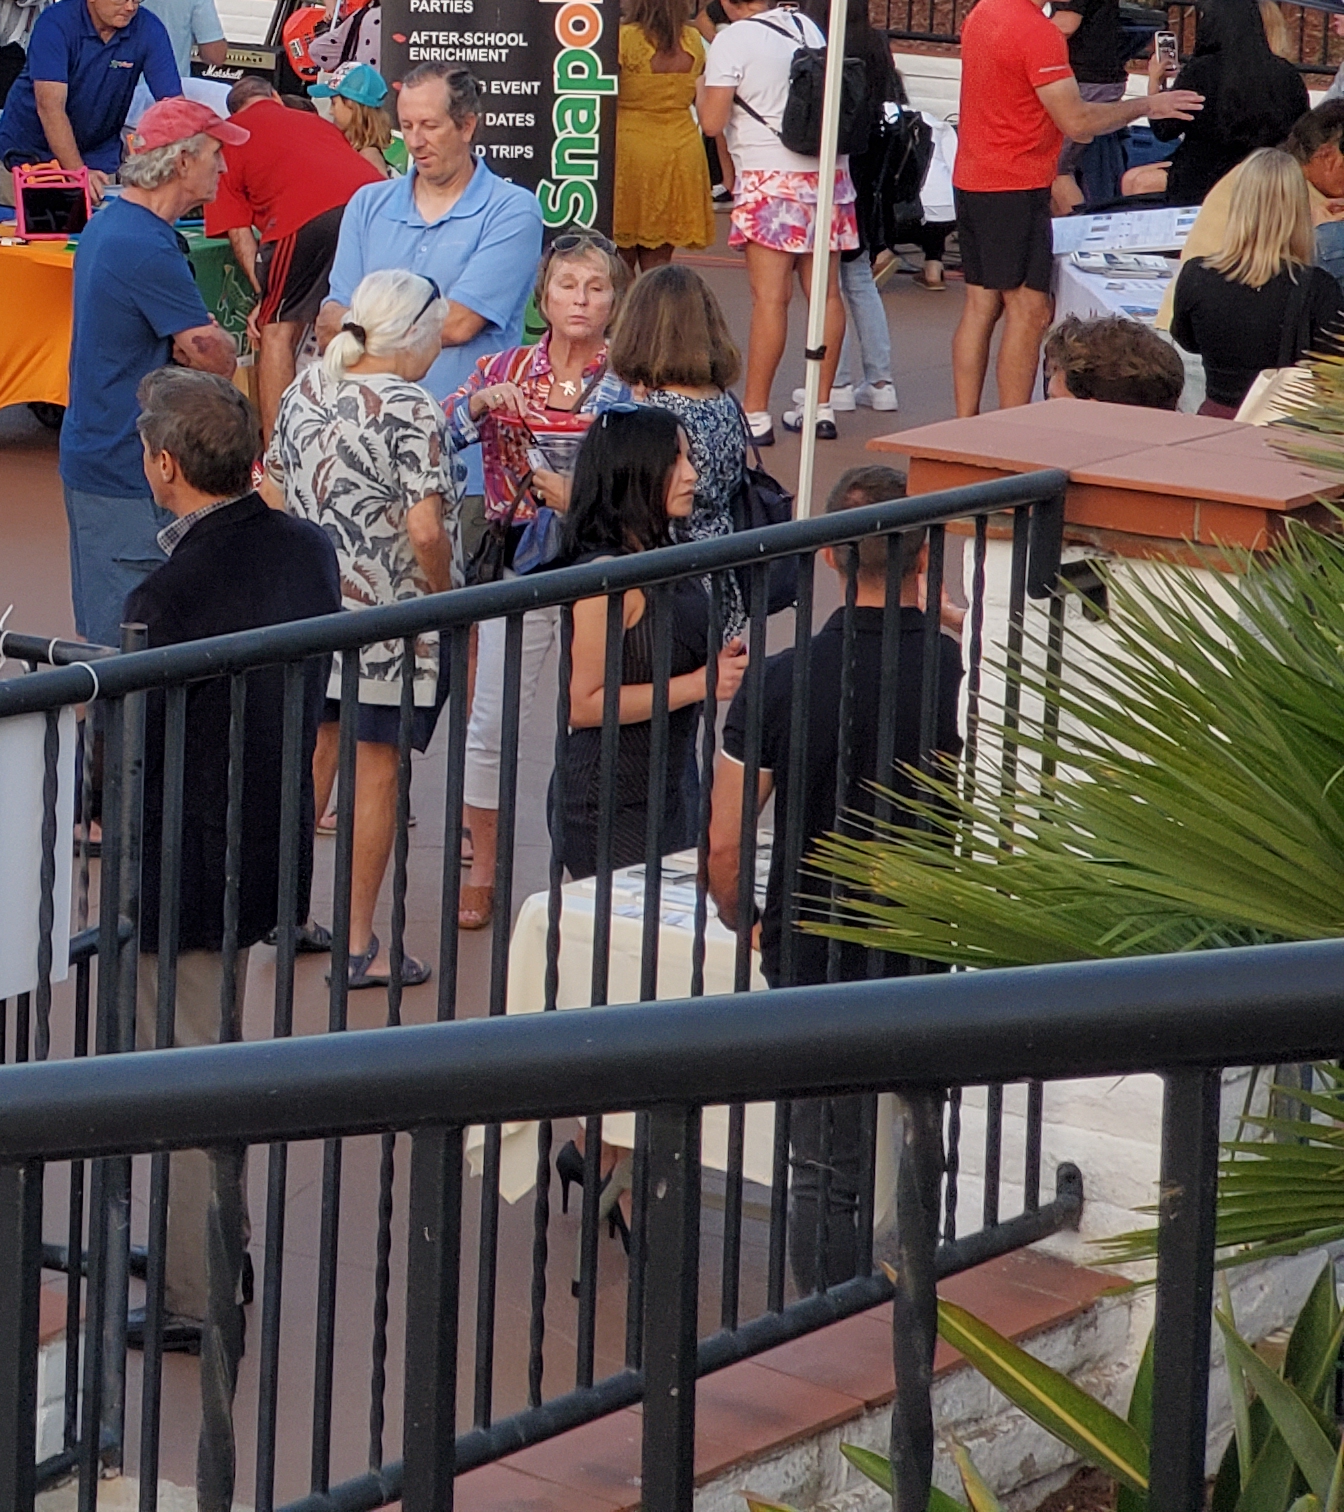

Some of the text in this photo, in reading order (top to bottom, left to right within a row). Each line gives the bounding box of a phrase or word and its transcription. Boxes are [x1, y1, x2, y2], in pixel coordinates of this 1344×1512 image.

[410, 0, 473, 13] PARTIES
[409, 31, 528, 46] AFTER-SCHOOL
[409, 47, 509, 62] ENRICHMENT
[201, 63, 244, 80] Marshall
[491, 81, 541, 94] EVENT
[485, 113, 535, 126] DATES
[489, 145, 534, 158] TRIPS
